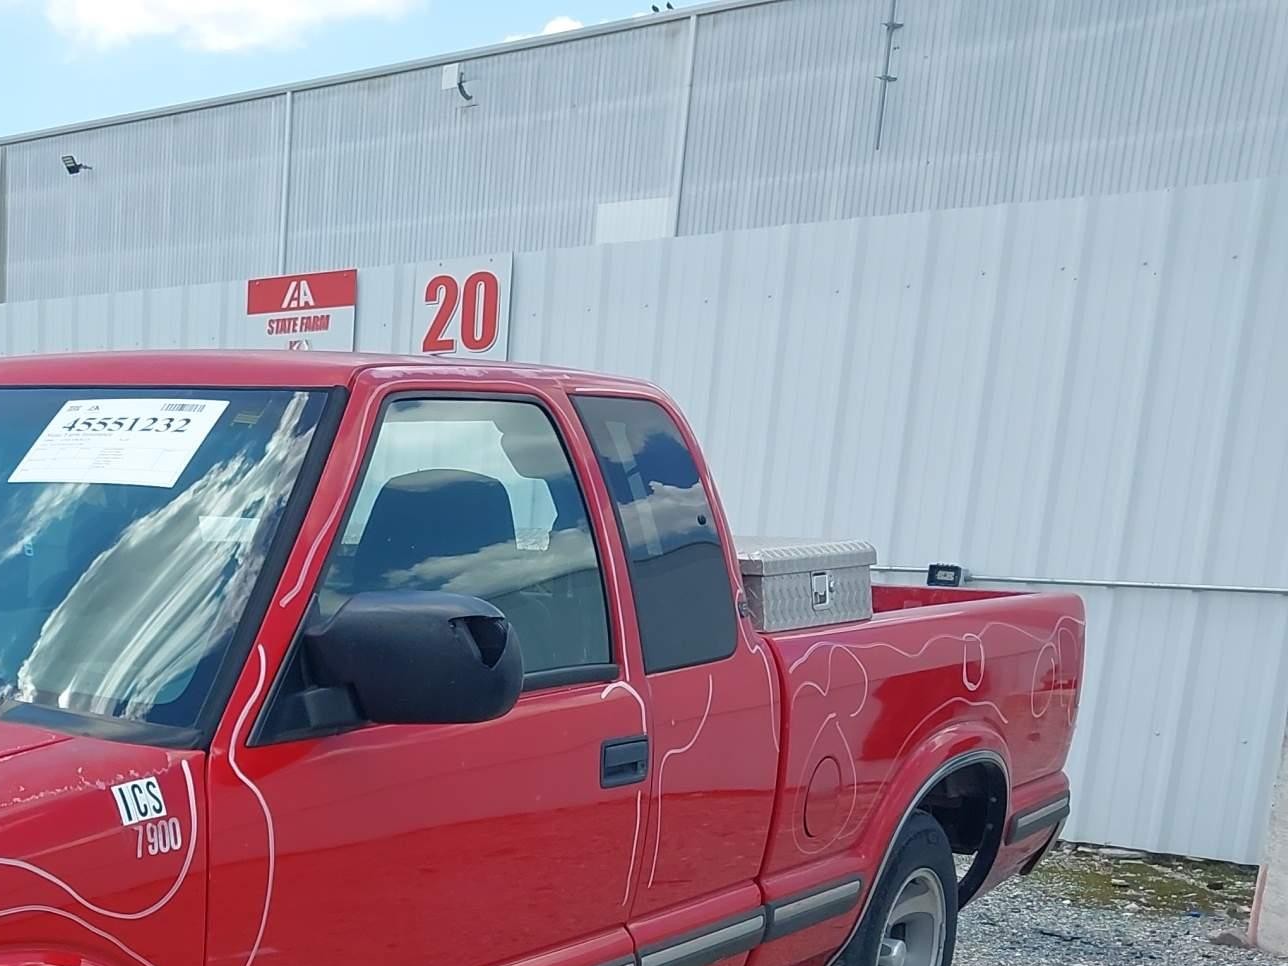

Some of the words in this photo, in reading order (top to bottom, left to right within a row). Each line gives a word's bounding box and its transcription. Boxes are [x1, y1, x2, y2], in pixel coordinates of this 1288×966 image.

[267, 317, 299, 335] STATE
[299, 314, 331, 333] FARM
[423, 271, 500, 353] 20
[61, 416, 192, 433] 45551232
[118, 780, 163, 822] ICS
[133, 817, 182, 858] 7900
